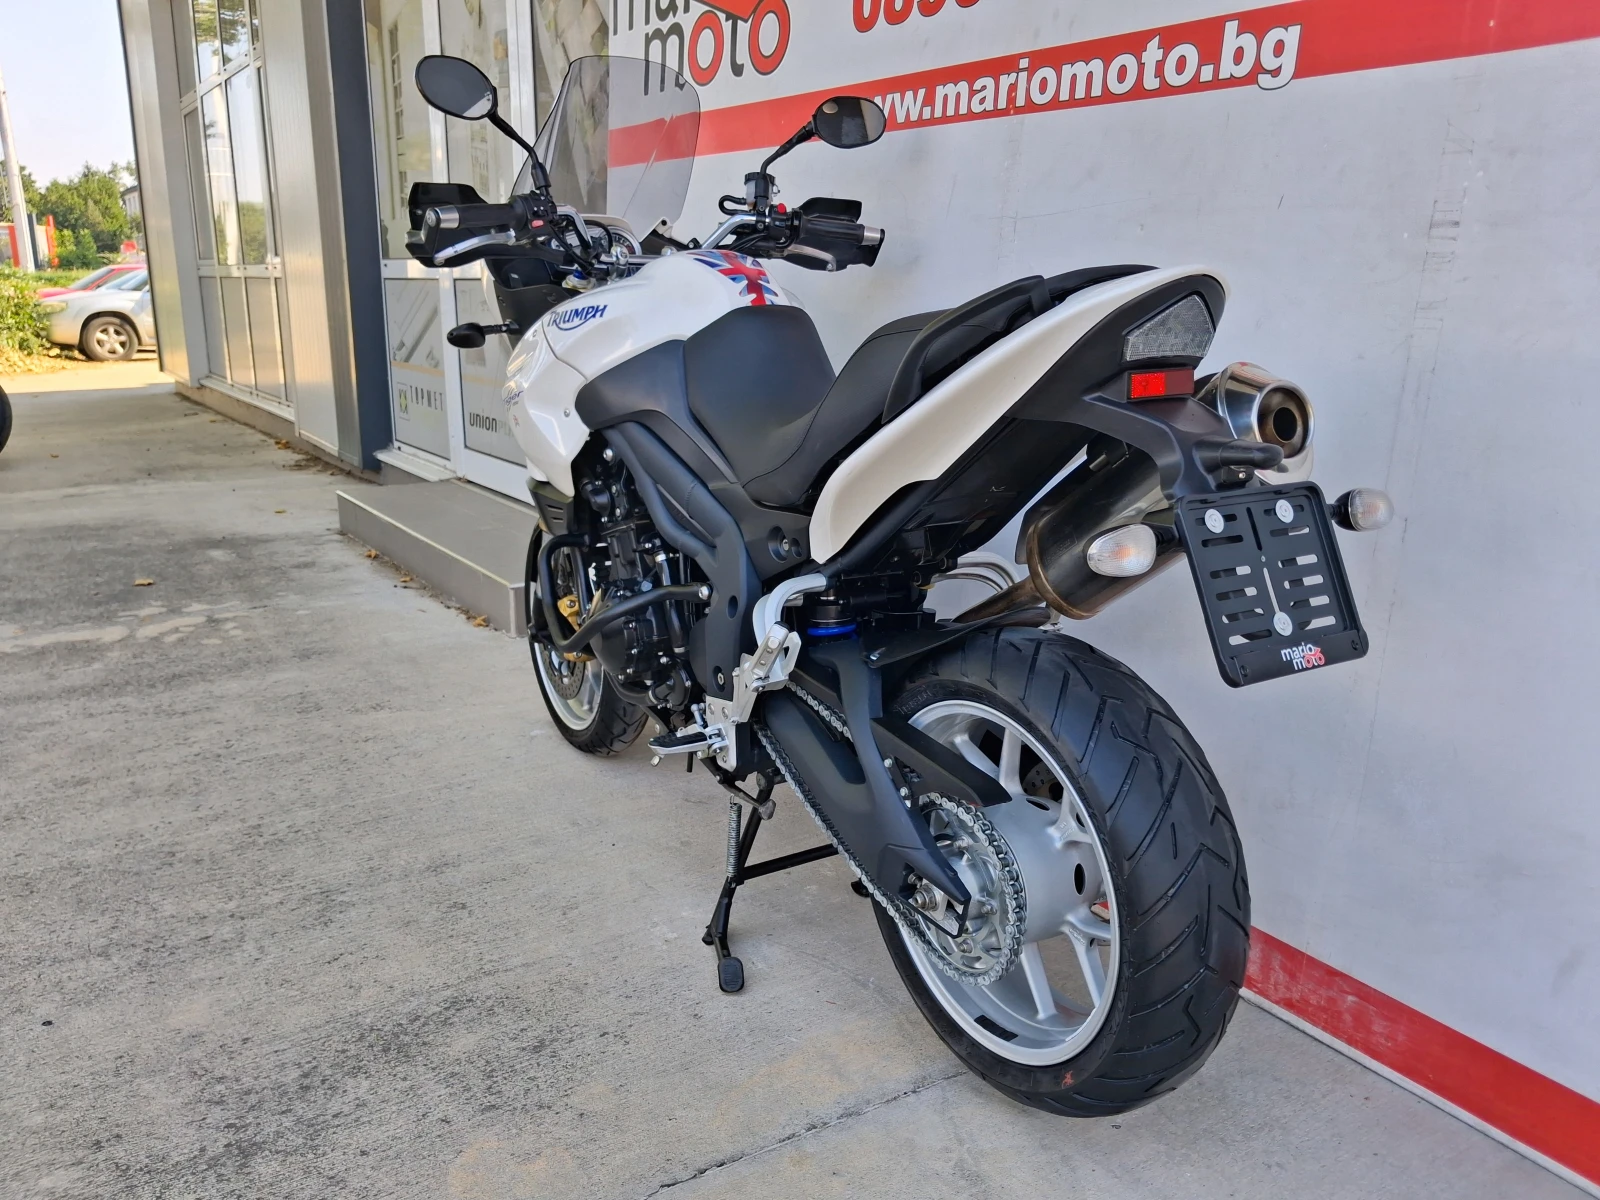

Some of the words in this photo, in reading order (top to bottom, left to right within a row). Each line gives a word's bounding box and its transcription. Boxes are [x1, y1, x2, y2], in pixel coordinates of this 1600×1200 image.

[644, 0, 791, 96] moto
[547, 304, 608, 331] TRIUMPH
[1281, 642, 1314, 661] mario
[1293, 653, 1325, 670] moto
